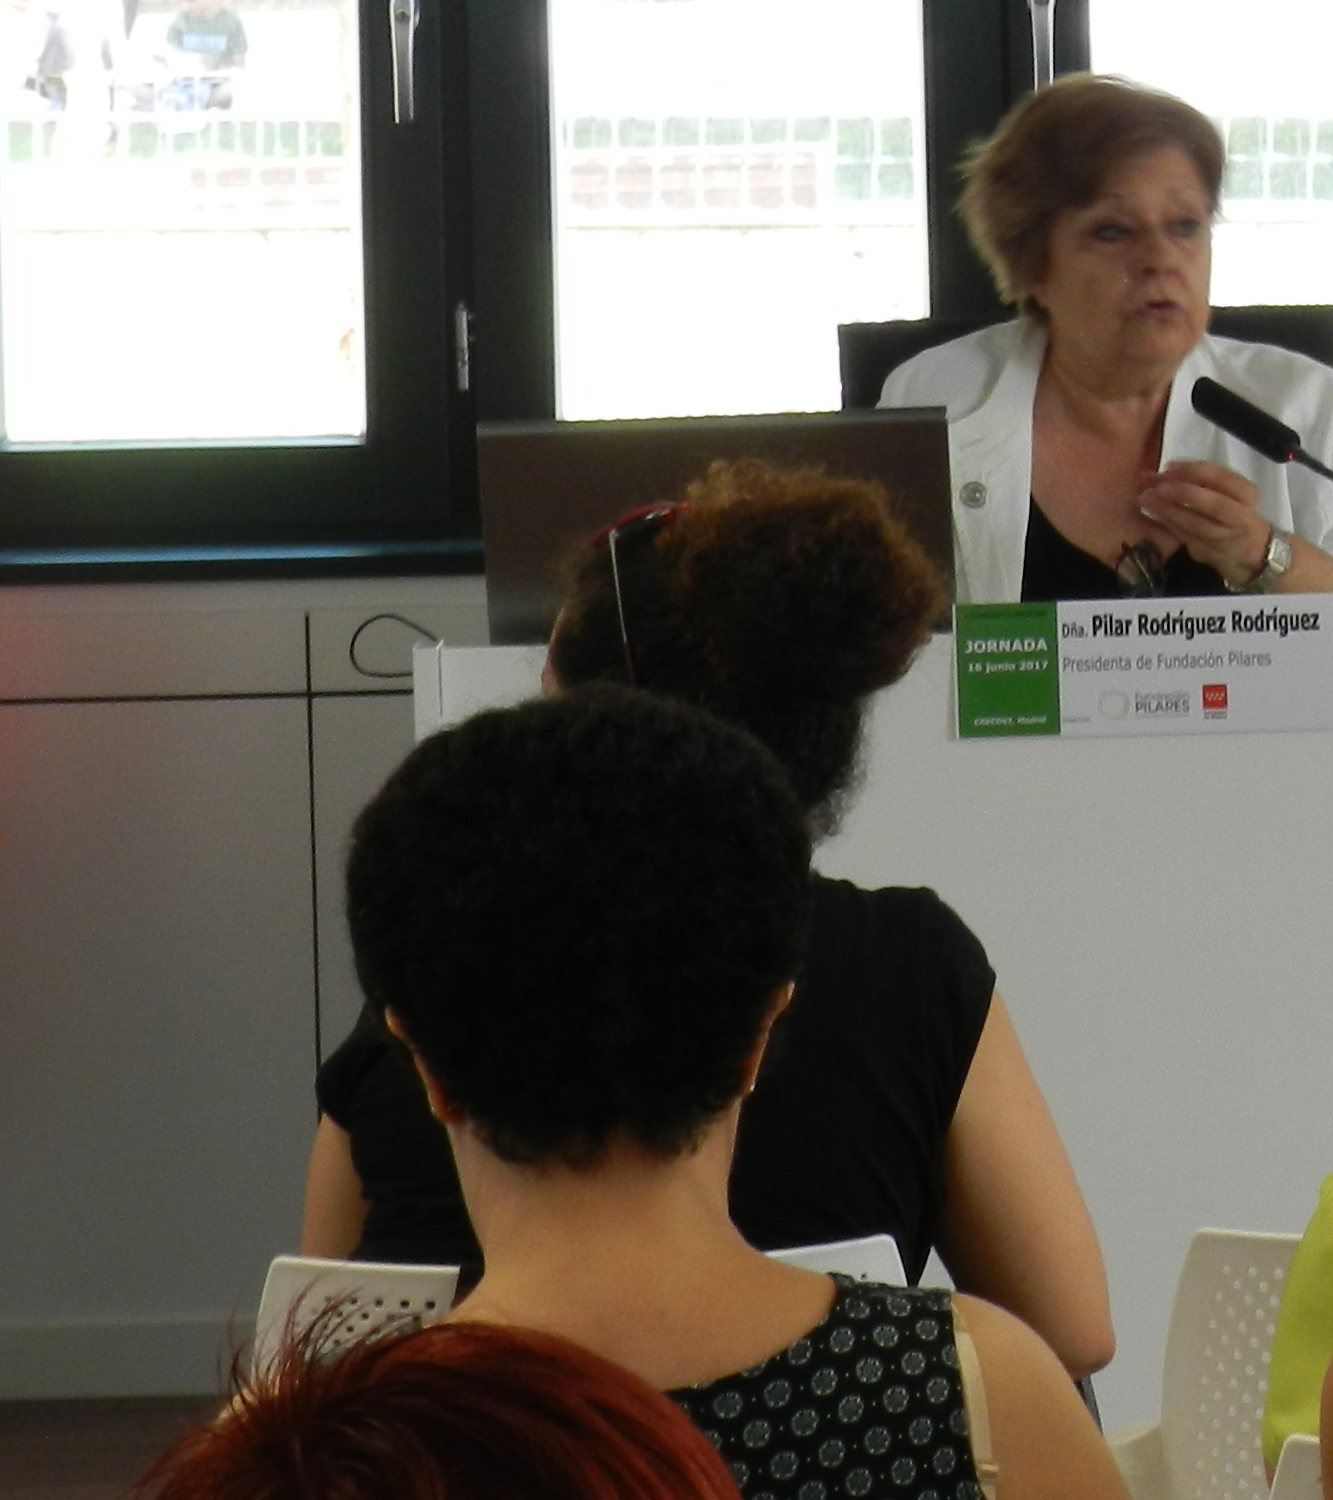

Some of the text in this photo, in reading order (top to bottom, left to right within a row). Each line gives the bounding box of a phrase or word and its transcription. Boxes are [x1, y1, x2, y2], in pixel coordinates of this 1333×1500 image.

[1061, 606, 1321, 641] Dña. Pilar Rodríguez Rodríguez
[965, 637, 1048, 654] JORNADA
[1019, 660, 1049, 671] 2017
[1062, 649, 1272, 674] Presidenta de Fundación Pilares
[1134, 701, 1190, 714] PILARES
